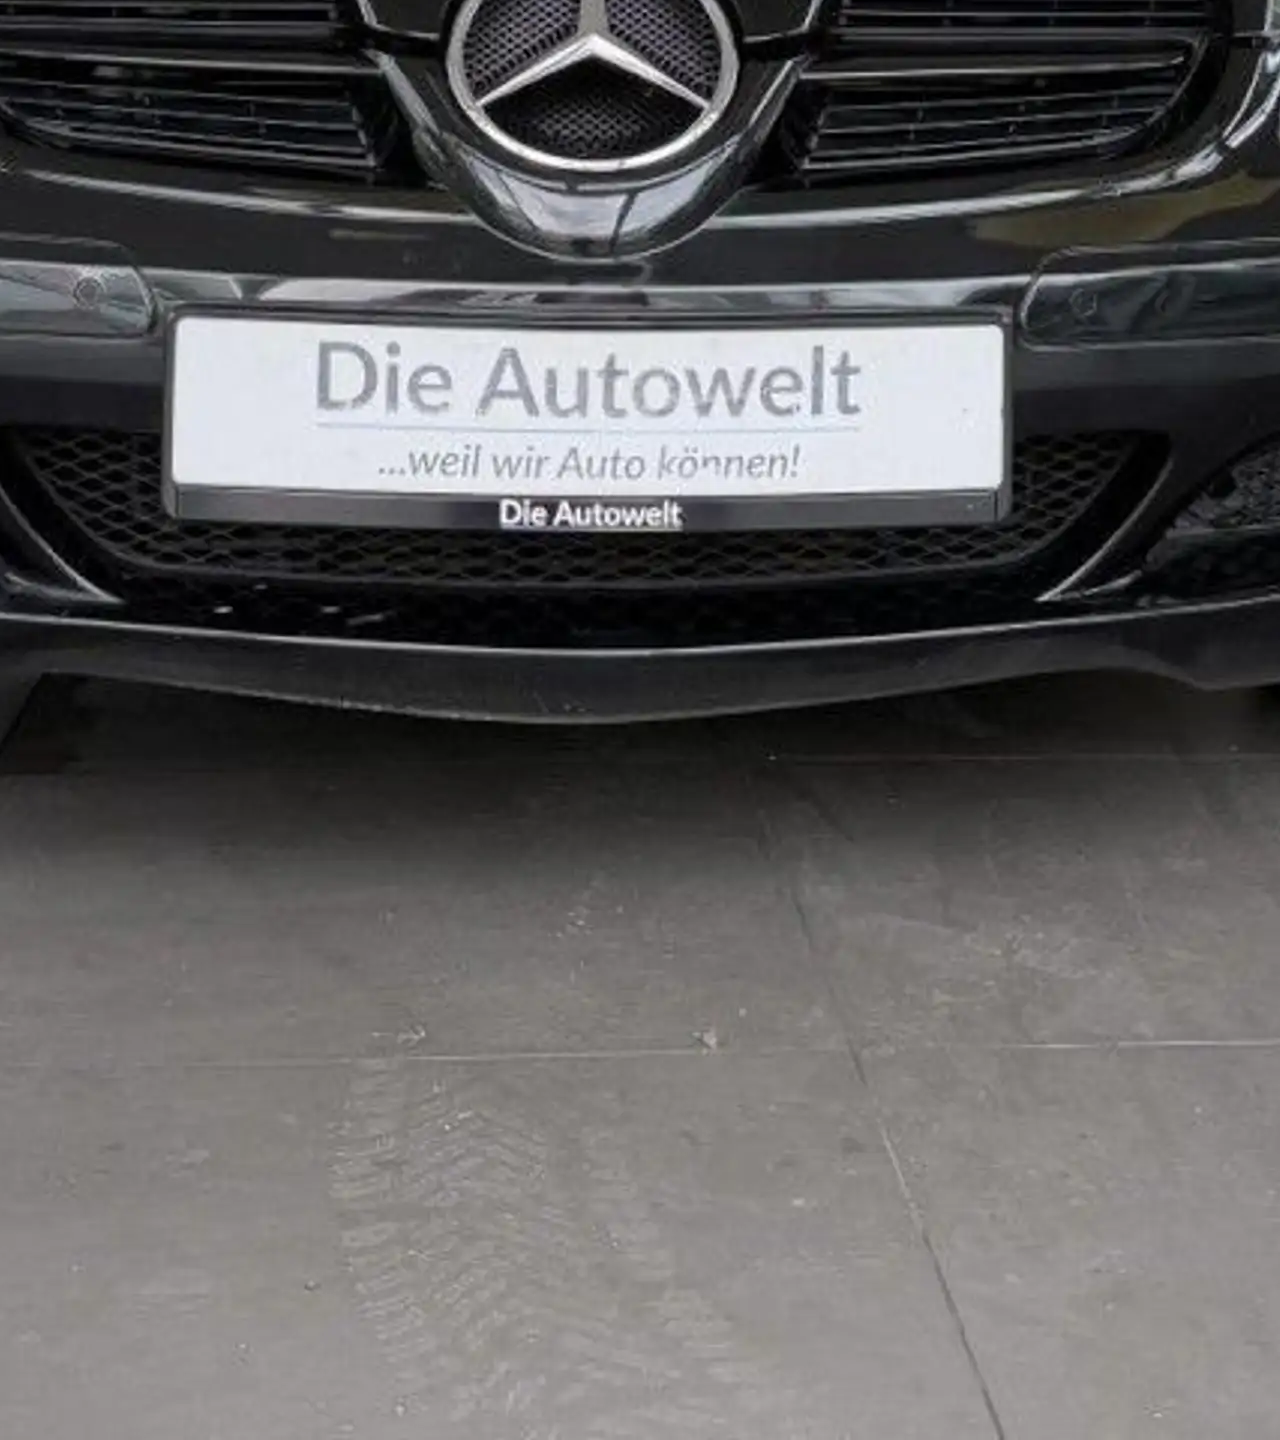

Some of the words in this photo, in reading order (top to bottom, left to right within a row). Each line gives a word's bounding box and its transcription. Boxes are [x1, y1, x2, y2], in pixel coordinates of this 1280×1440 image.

[317, 340, 452, 416] Die
[475, 345, 862, 418] Autowelt
[378, 443, 482, 478] ...weil
[490, 445, 551, 480] wir
[556, 446, 646, 481] Auto
[658, 443, 800, 481] können!
[499, 497, 548, 528] Die
[553, 498, 685, 529] Autowelt
